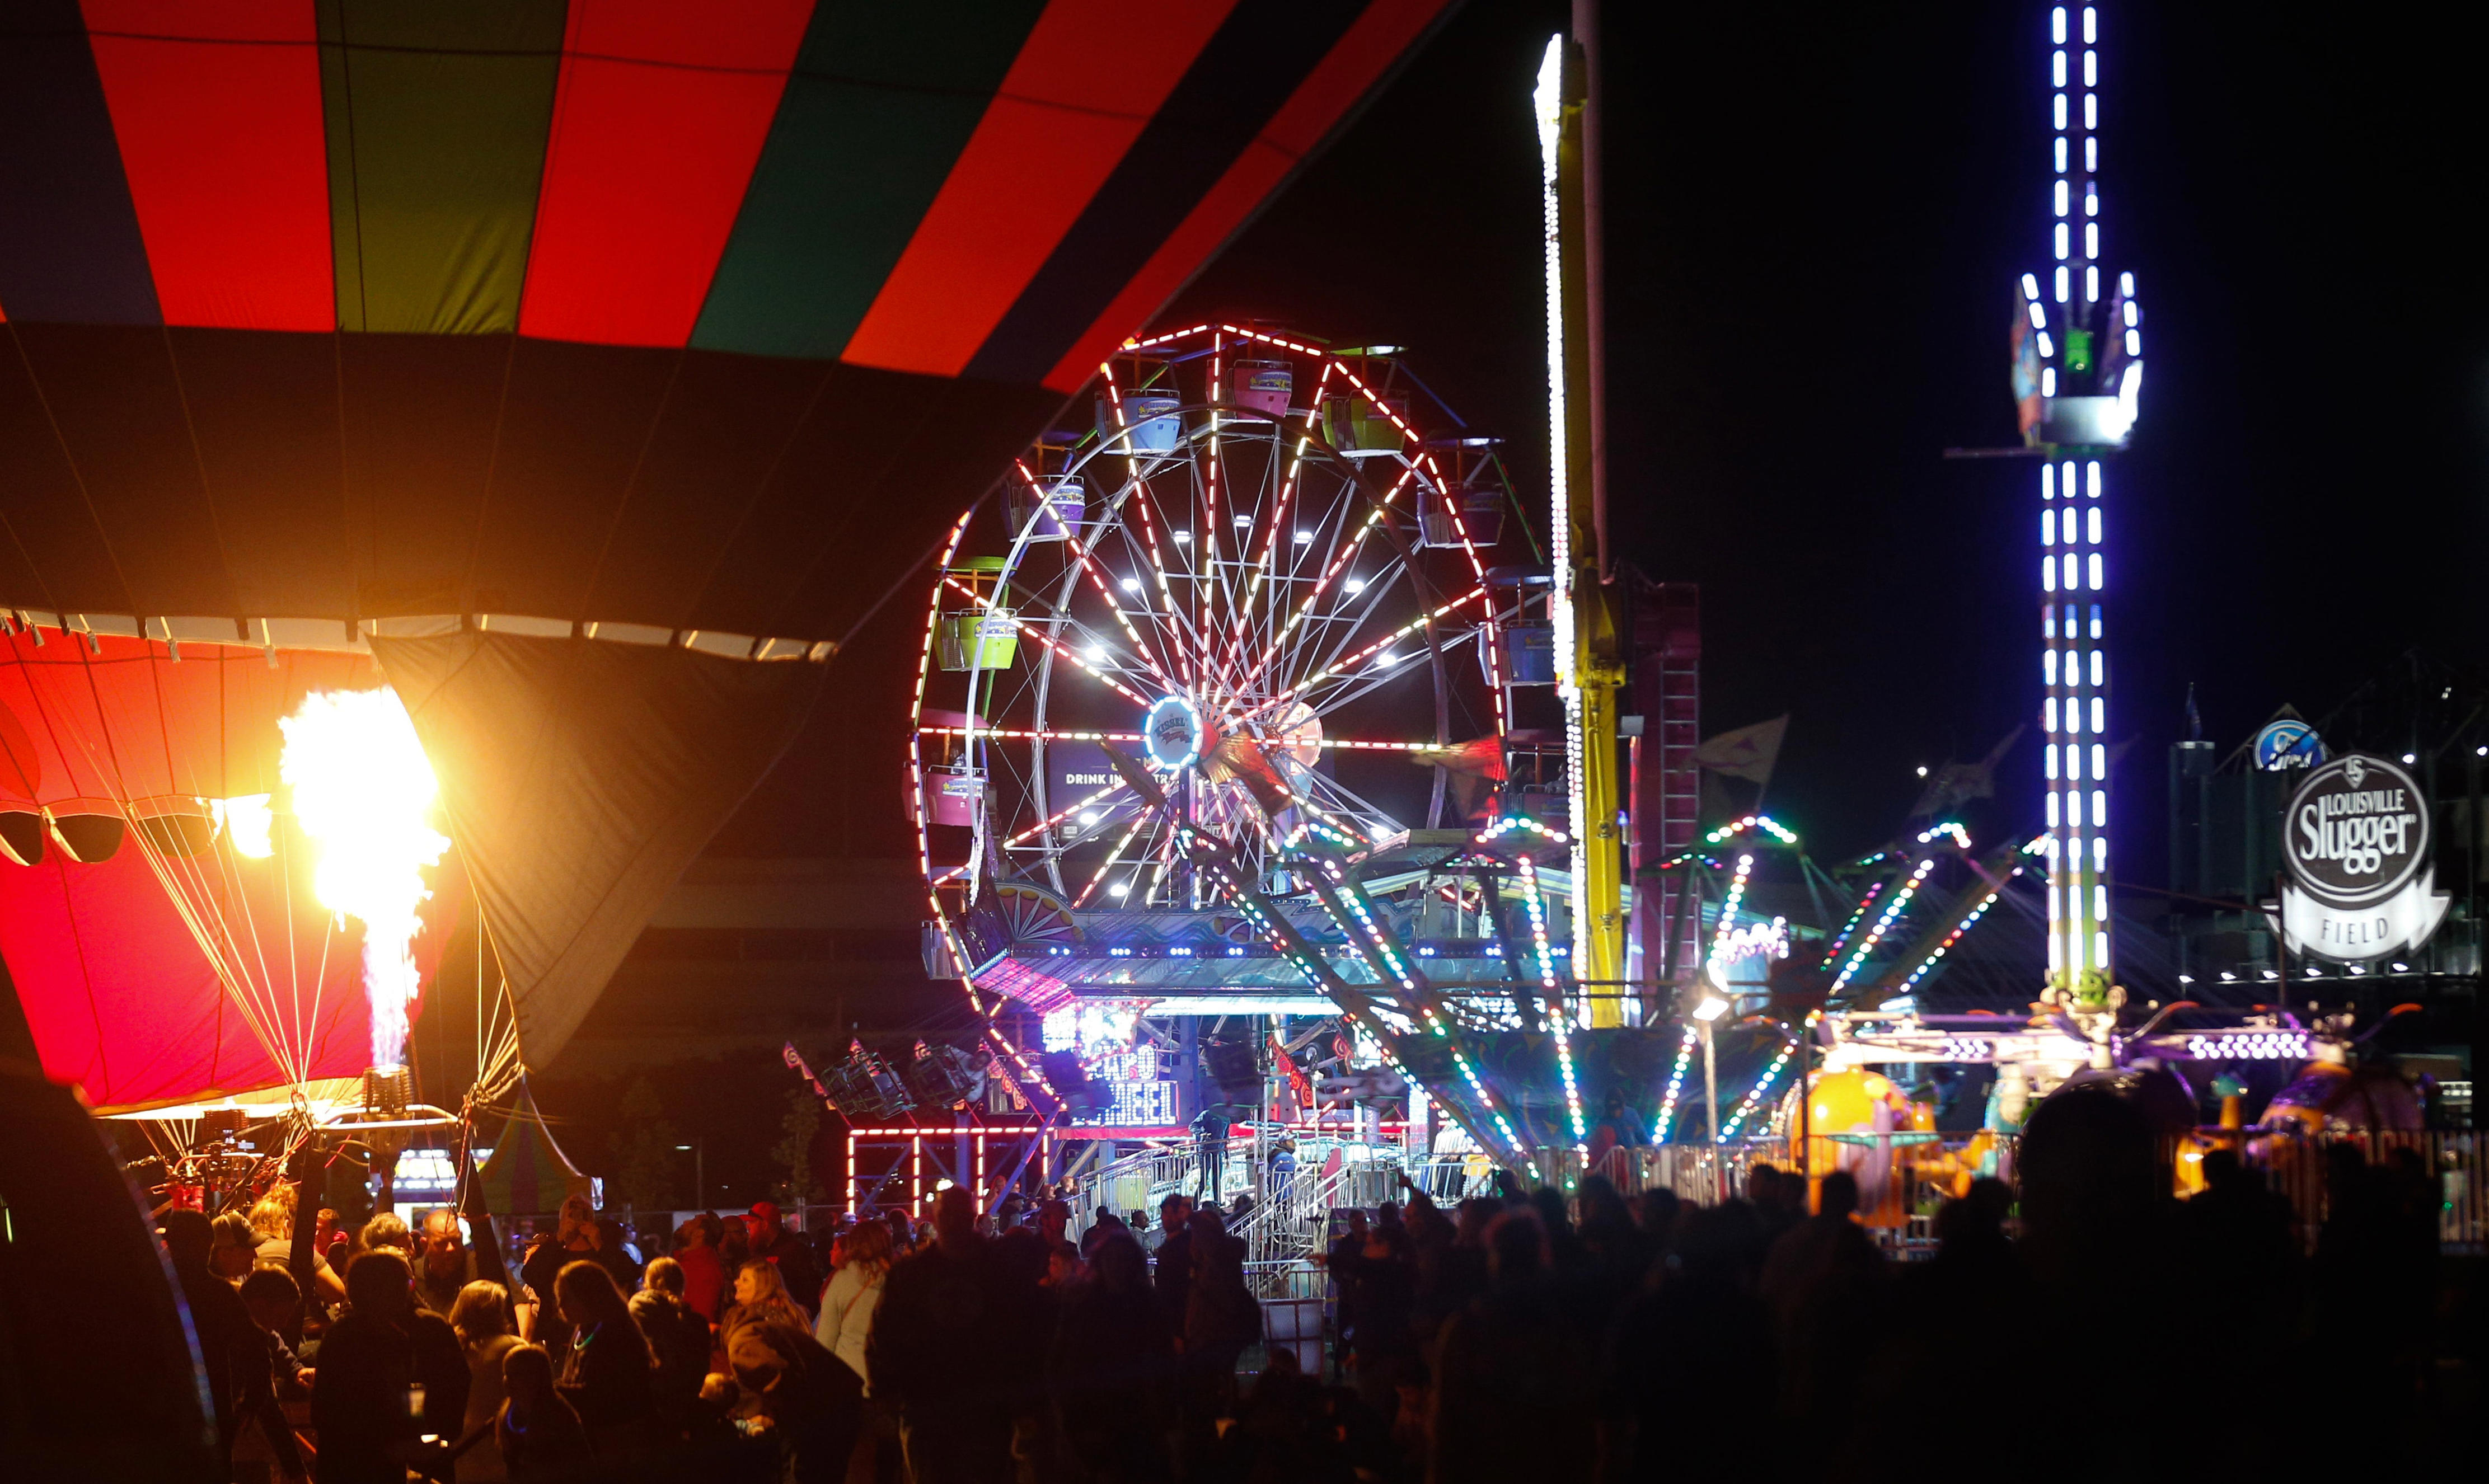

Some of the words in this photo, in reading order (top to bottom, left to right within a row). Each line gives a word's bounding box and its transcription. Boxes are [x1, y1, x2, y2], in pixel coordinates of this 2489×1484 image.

[1066, 774, 1107, 785] DRINK
[2326, 789, 2405, 816] LOUISVILLE
[2299, 793, 2410, 875] Slugger
[2321, 918, 2389, 945] FIELD
[1072, 1082, 1176, 1125] HEEL
